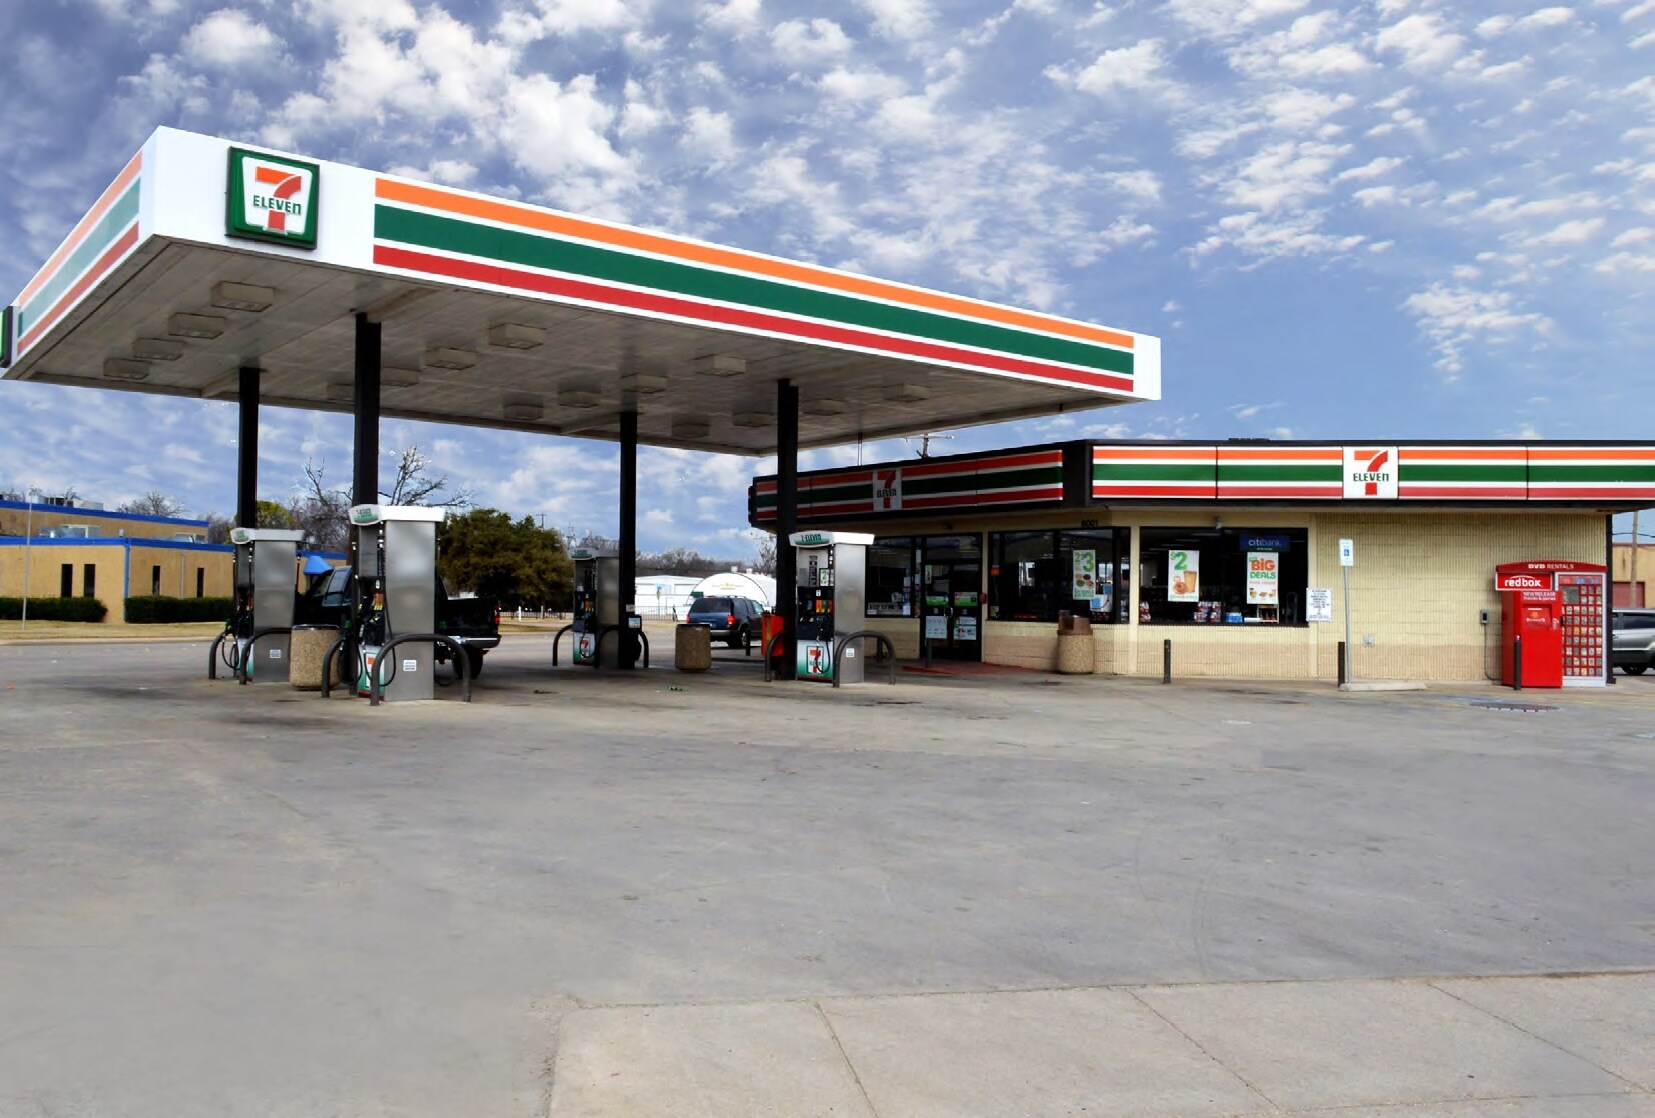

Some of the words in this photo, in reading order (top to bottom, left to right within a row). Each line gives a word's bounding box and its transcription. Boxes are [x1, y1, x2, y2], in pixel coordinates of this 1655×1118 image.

[255, 166, 302, 231] 7
[877, 470, 896, 508] 7
[1354, 450, 1388, 496] 7
[1250, 571, 1276, 579] DEALS
[1504, 578, 1541, 587] redbox
